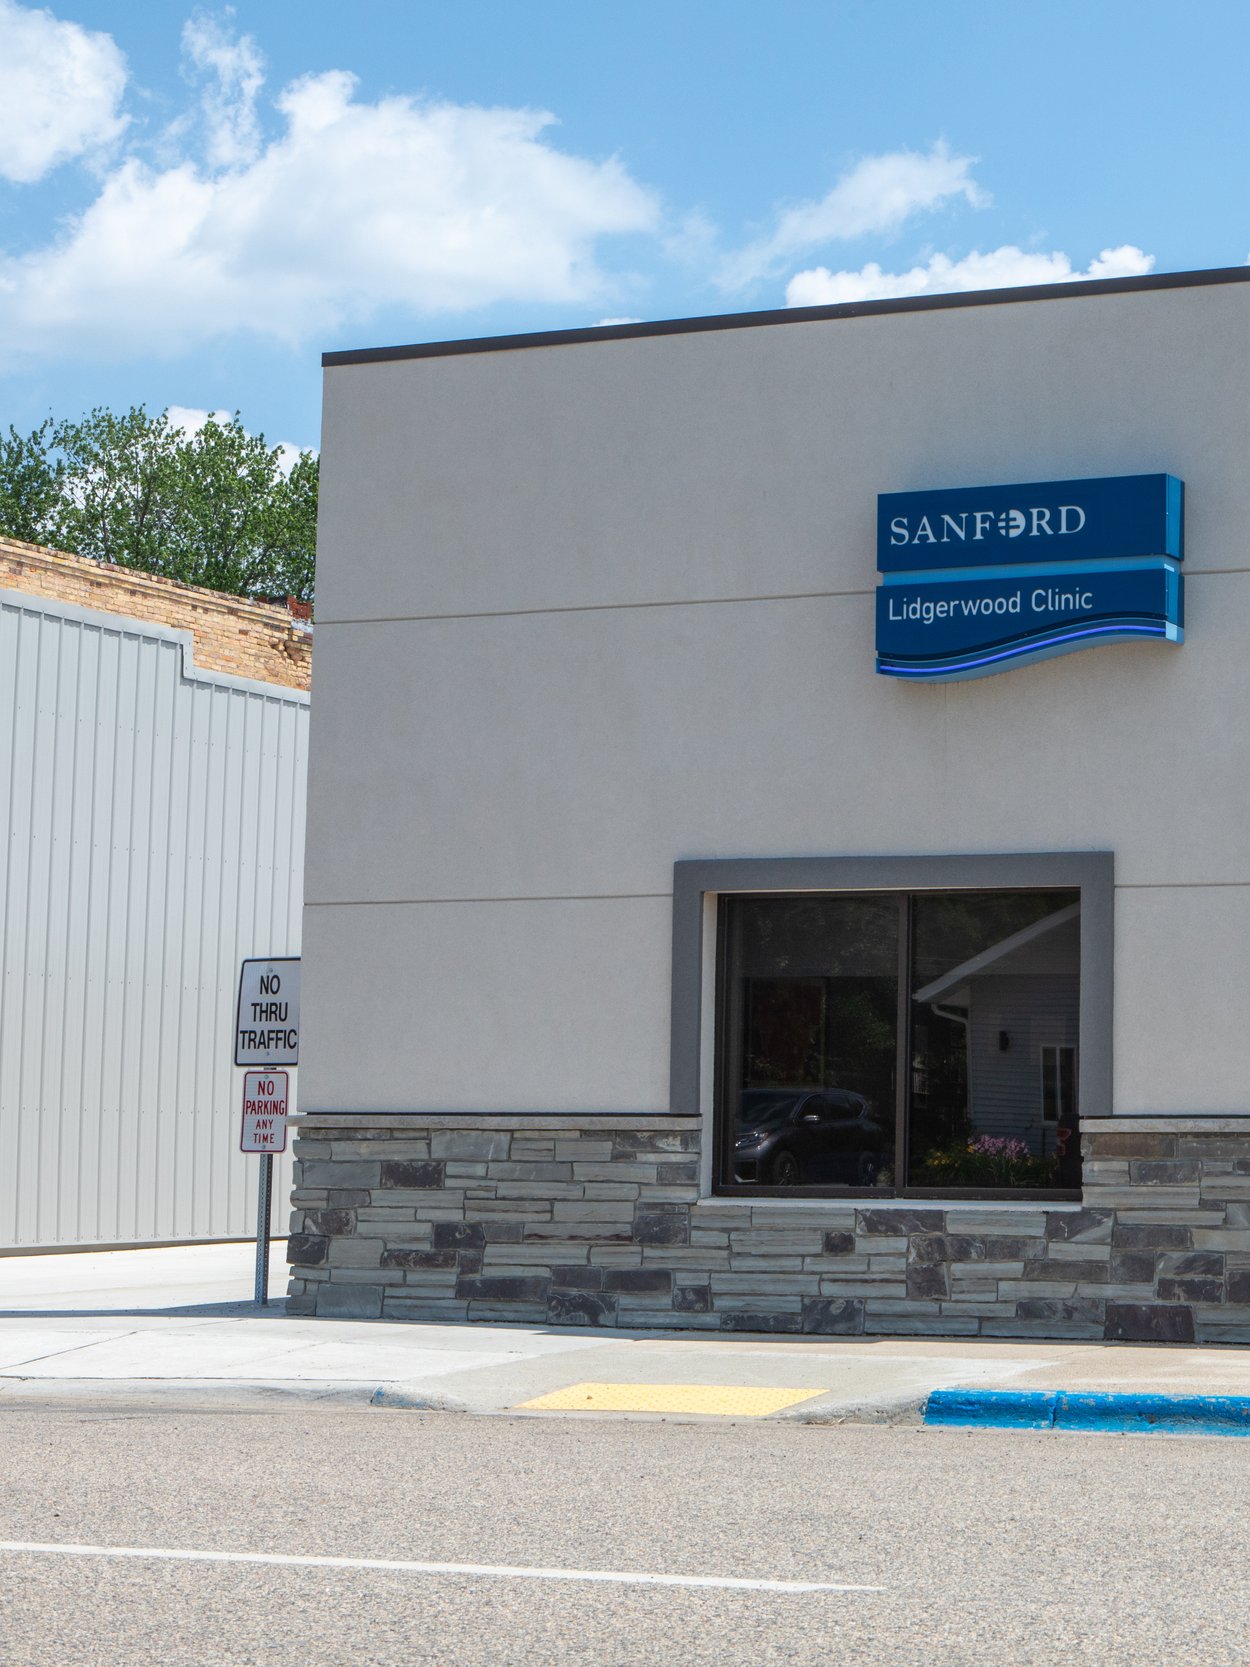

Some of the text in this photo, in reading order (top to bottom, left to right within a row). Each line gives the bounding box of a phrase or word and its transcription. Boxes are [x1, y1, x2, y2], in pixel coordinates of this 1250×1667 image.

[890, 505, 1086, 545] SANFORD
[889, 587, 1093, 624] Lidgerwood Clinic
[260, 975, 280, 995] NO
[251, 1002, 288, 1022] THRU
[239, 1029, 298, 1050] TRAFFIC
[258, 1081, 275, 1096] NO
[245, 1100, 285, 1115] PARKING
[255, 1119, 274, 1130] ANY
[253, 1133, 275, 1144] TIME
